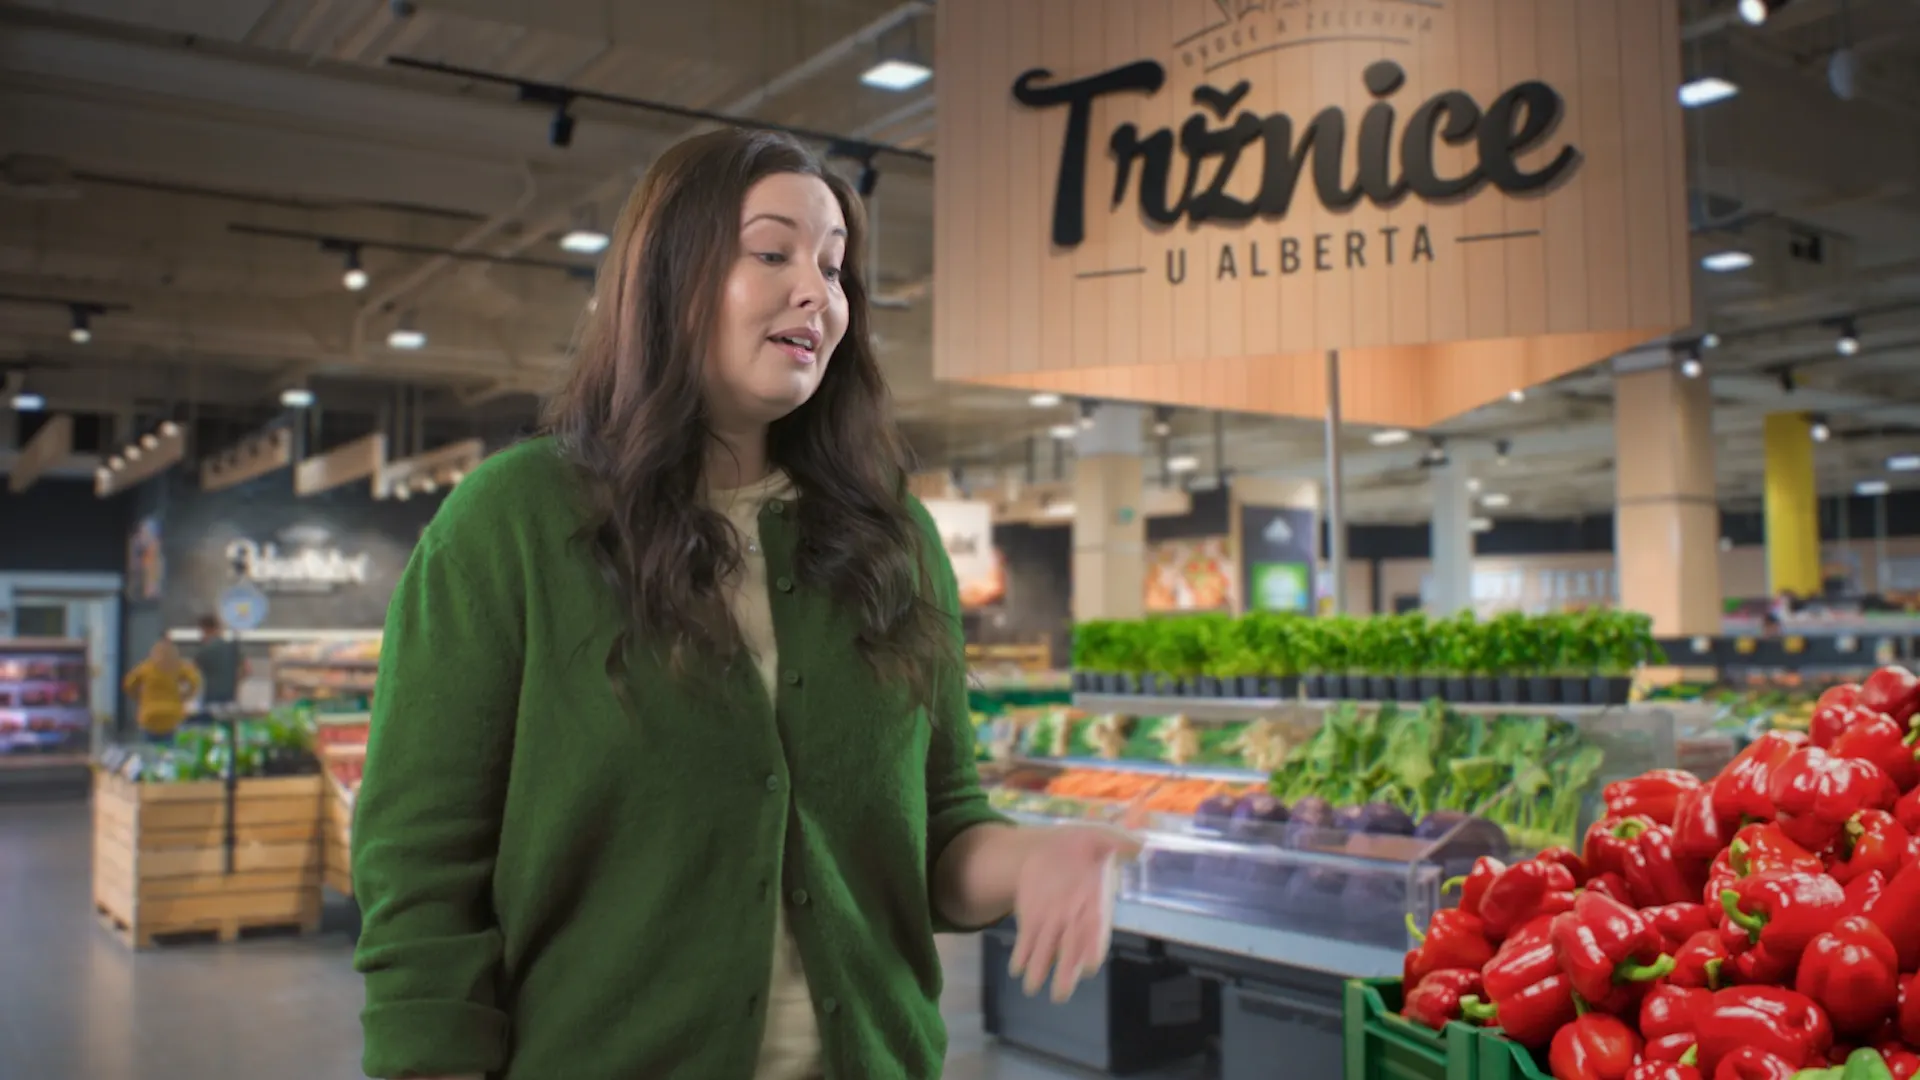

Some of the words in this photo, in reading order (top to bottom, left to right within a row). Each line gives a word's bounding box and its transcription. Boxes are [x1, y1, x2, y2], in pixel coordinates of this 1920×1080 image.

[1276, 16, 1287, 35] A
[1012, 59, 1581, 248] Tržnice
[1165, 249, 1189, 286] U
[1216, 224, 1435, 281] ALBERTA
